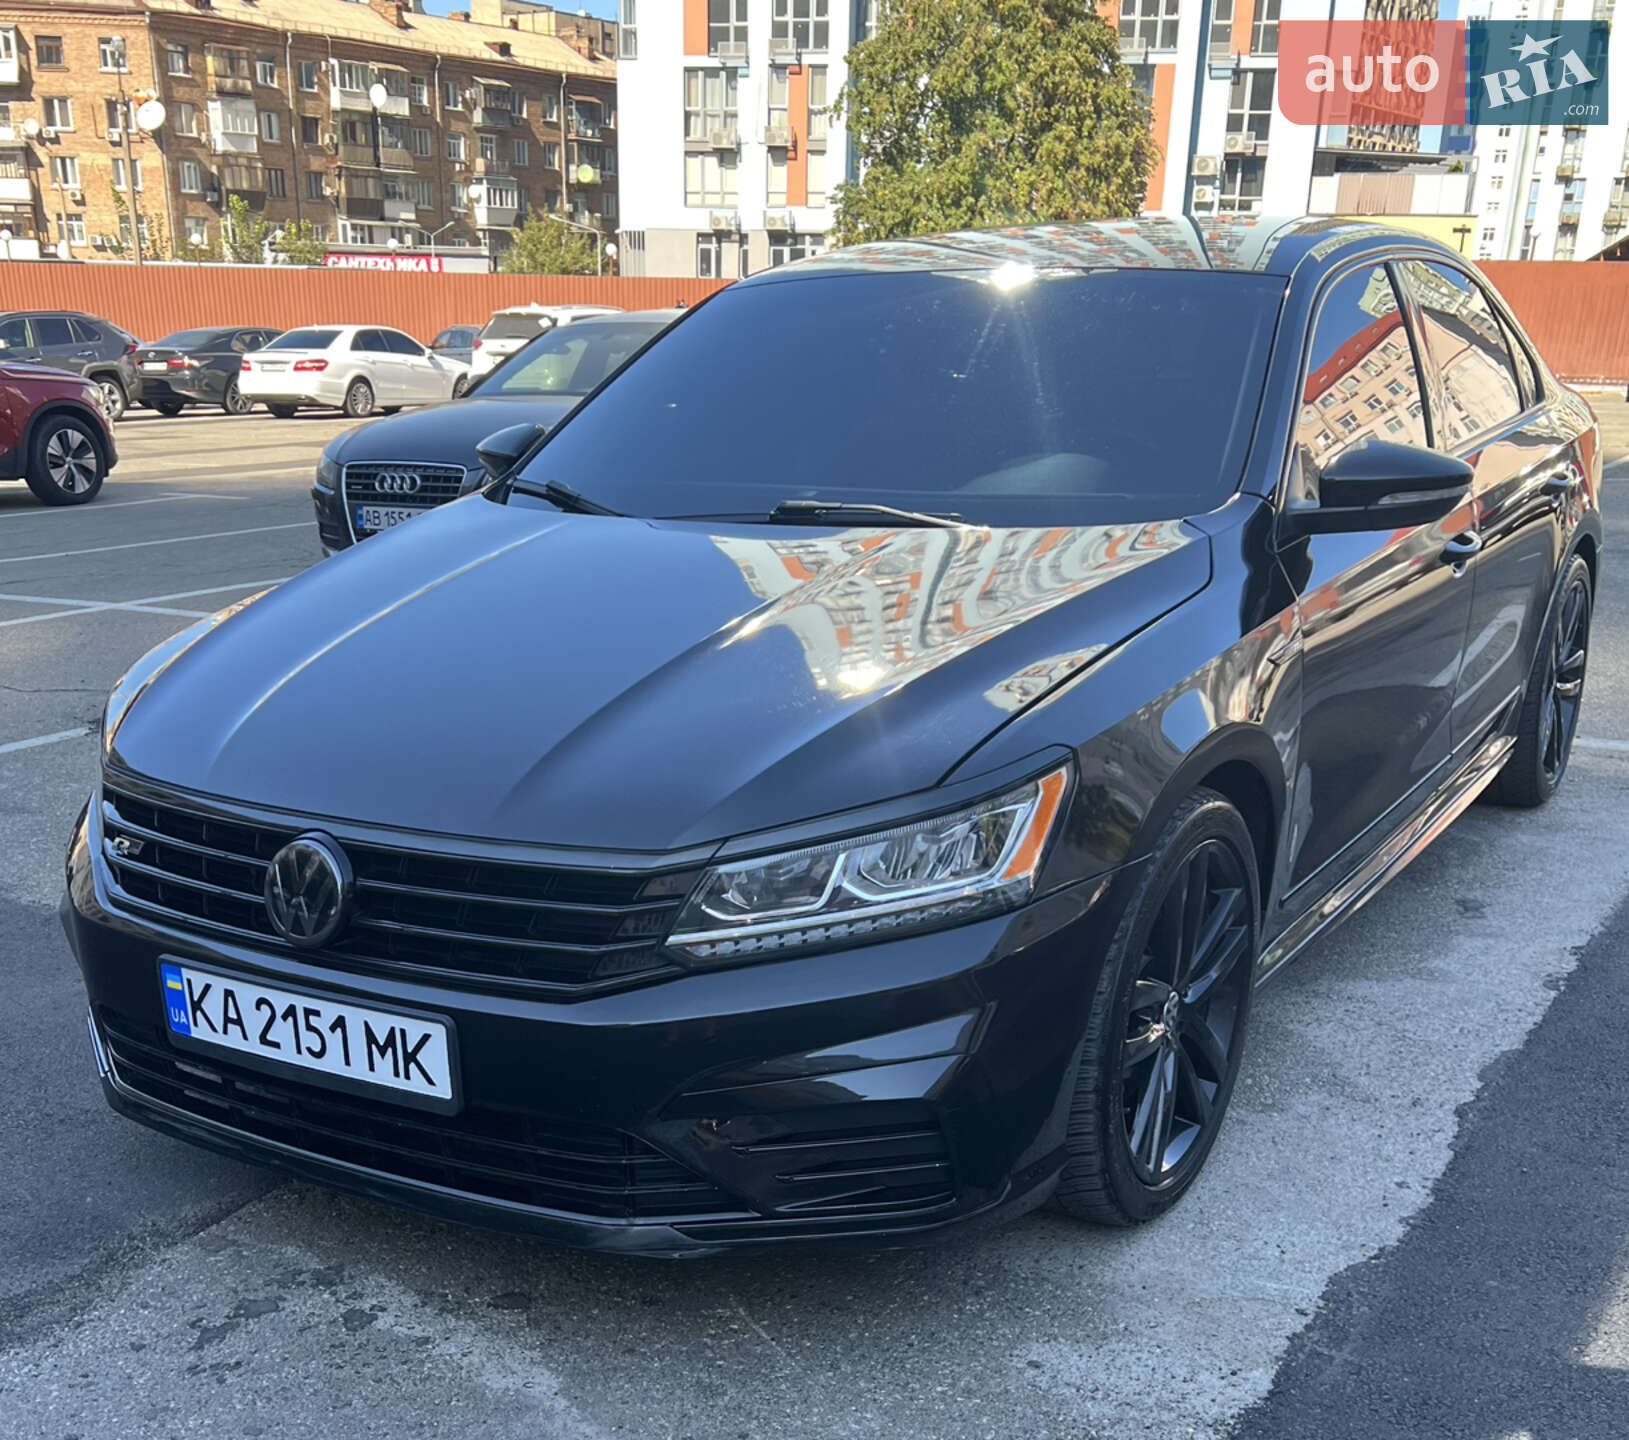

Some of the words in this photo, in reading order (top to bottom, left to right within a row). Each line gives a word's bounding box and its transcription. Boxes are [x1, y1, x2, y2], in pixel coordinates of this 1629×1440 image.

[365, 510, 381, 526] AB
[170, 1006, 188, 1025] UA
[186, 977, 249, 1042] KA
[255, 996, 351, 1067] 2151
[363, 1020, 437, 1087] MK
